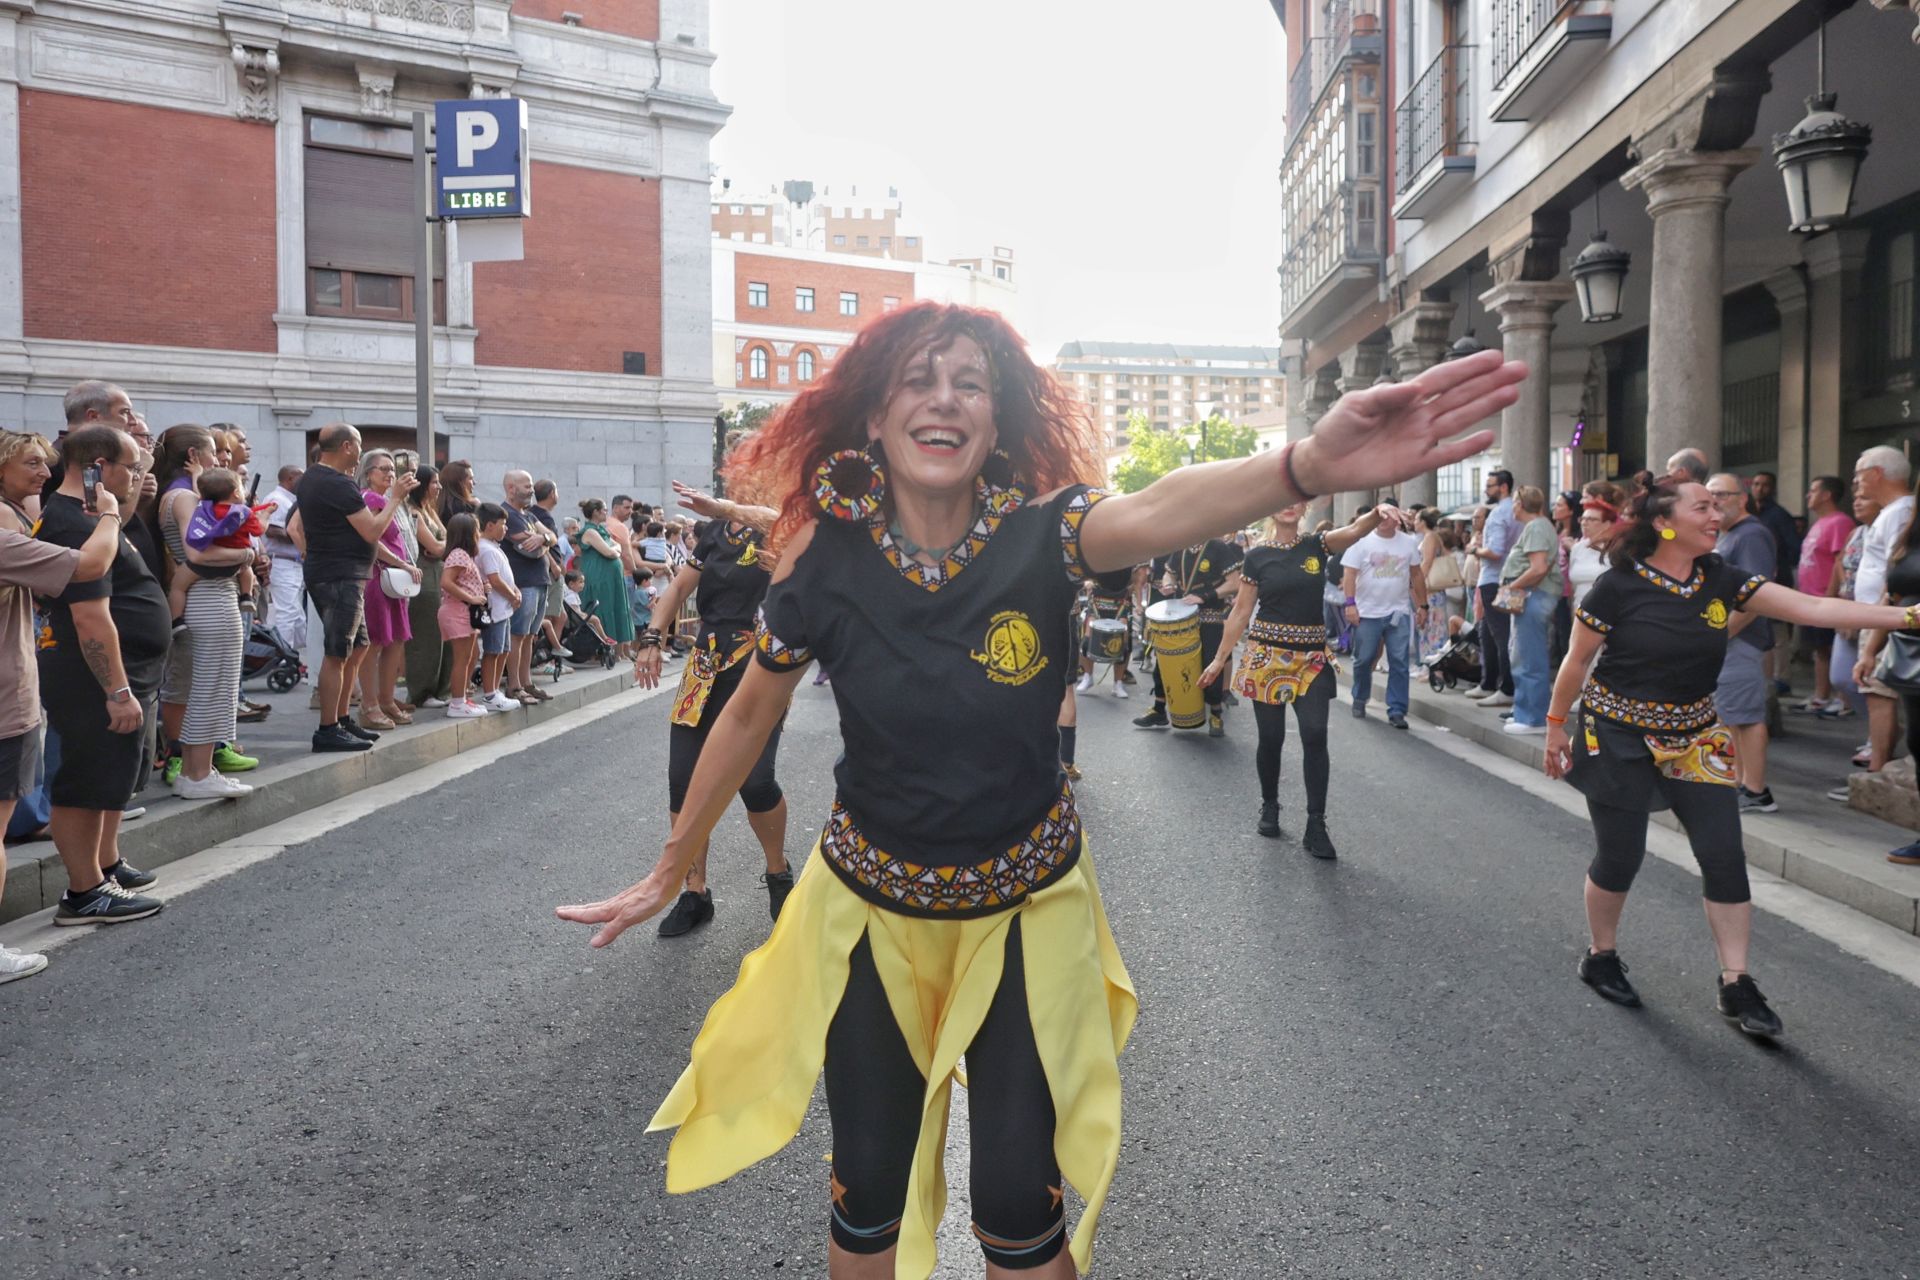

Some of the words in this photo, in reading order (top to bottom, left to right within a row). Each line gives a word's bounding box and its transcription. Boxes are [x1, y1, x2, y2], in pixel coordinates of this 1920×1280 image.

[456, 110, 499, 167] P
[450, 191, 507, 209] LIBRE
[970, 649, 988, 665] LA
